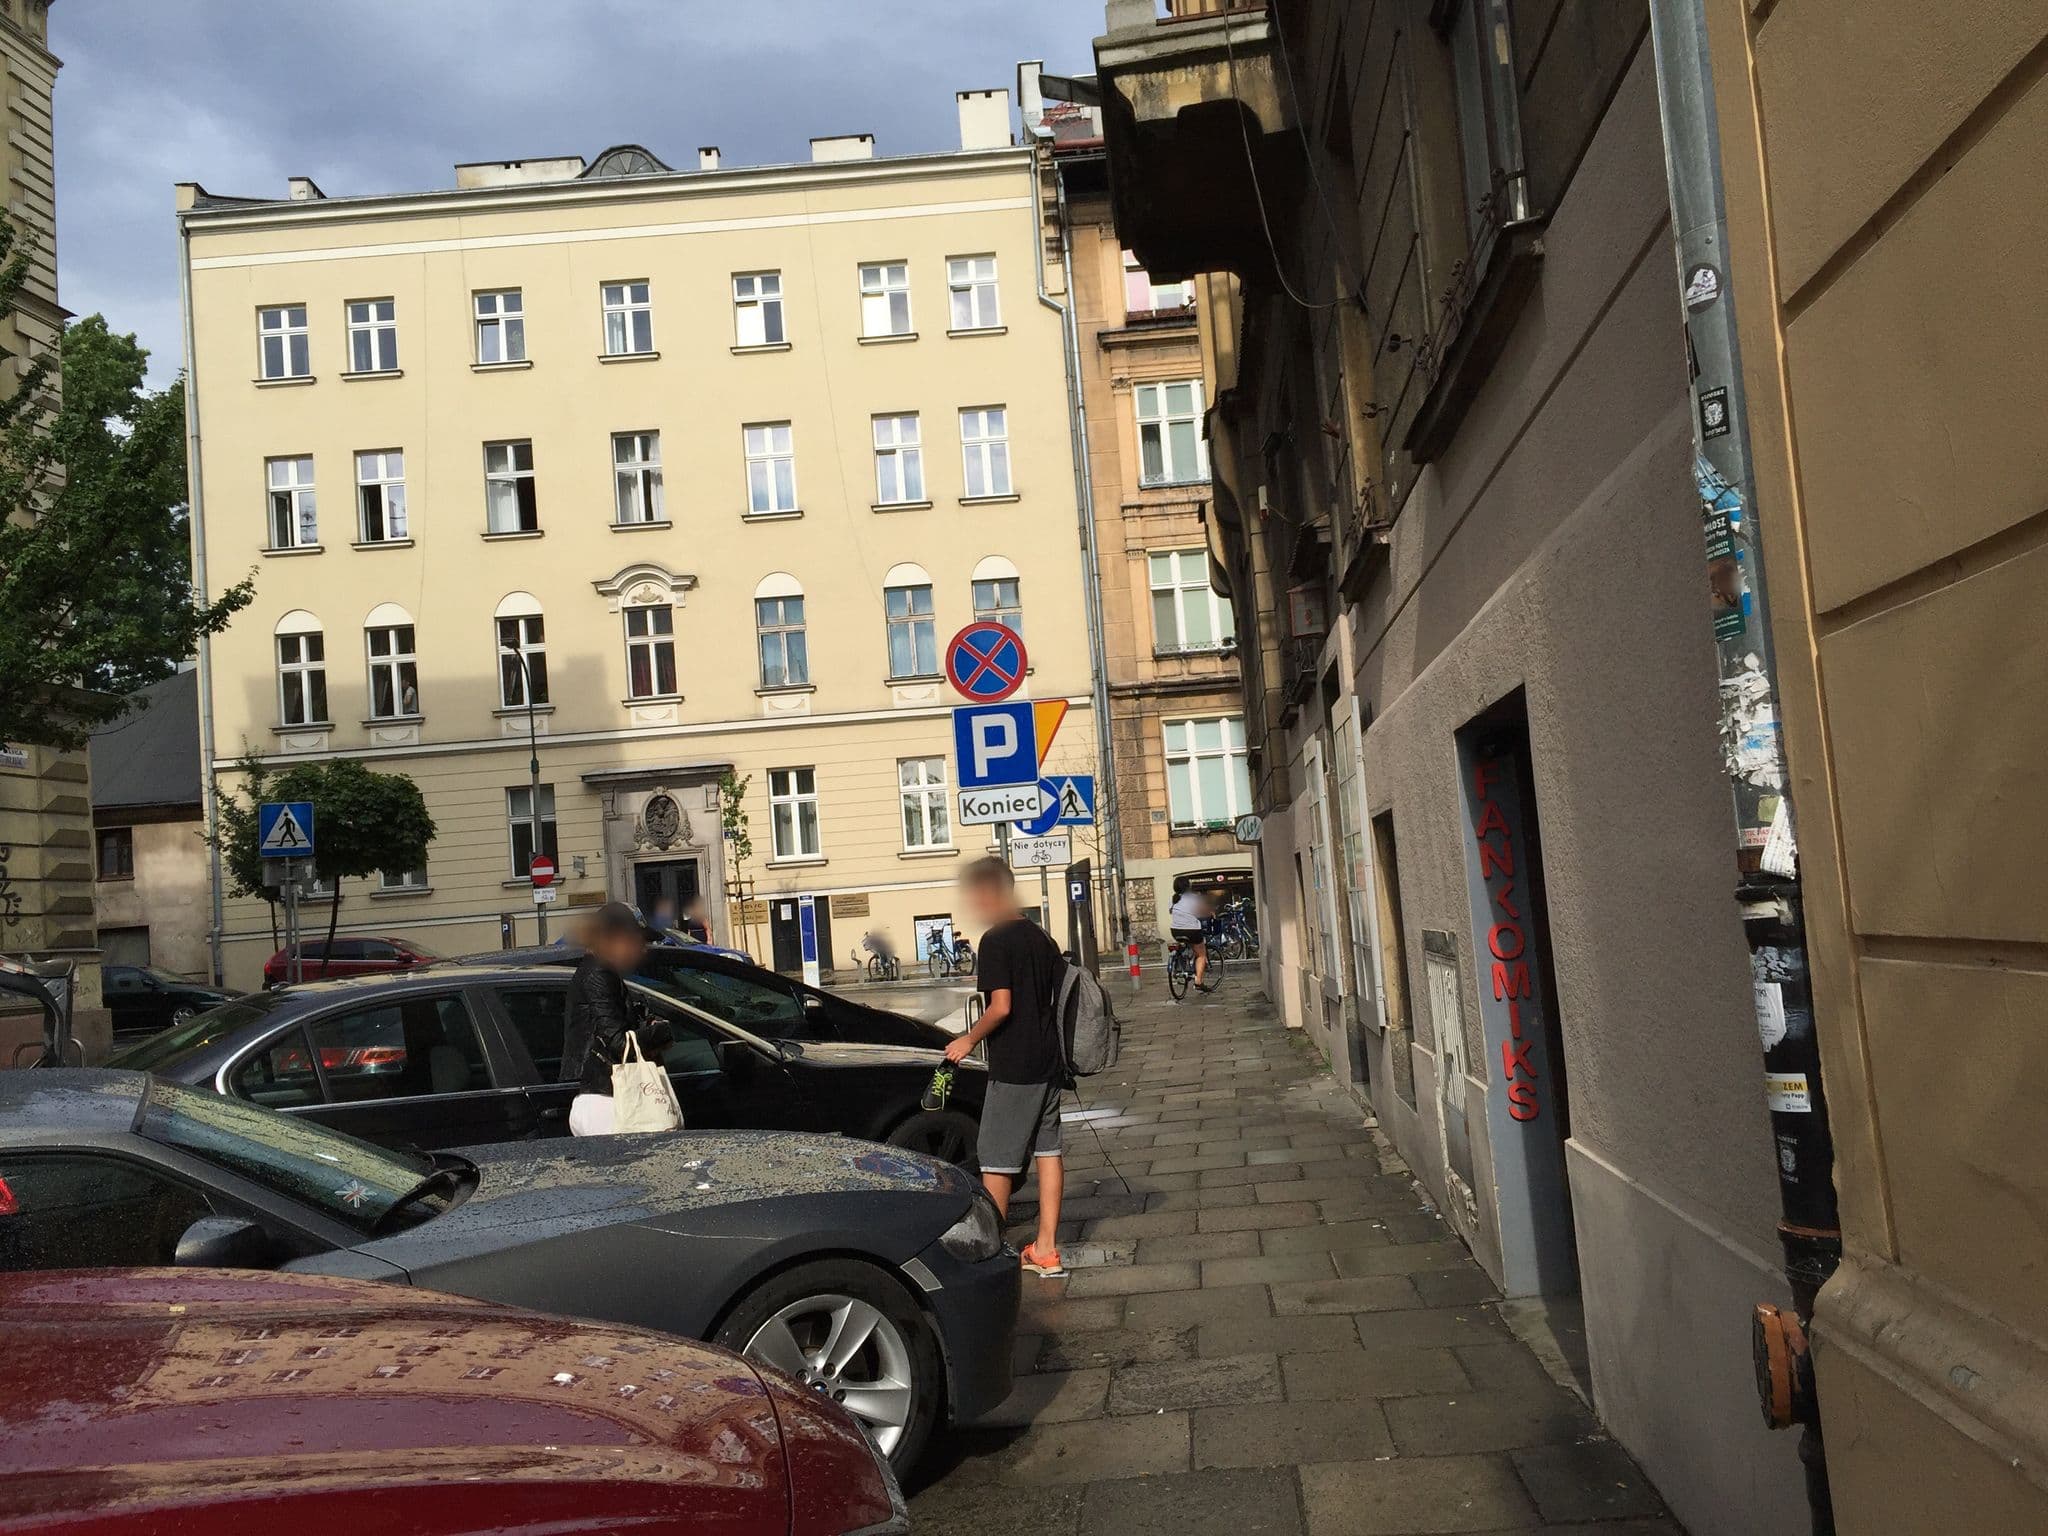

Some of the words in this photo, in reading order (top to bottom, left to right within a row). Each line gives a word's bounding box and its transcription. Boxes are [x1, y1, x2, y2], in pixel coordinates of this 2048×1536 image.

[971, 712, 1018, 778] P
[962, 793, 1038, 818] Koniec
[1014, 842, 1029, 850] Nie
[1033, 840, 1067, 849] dotyczy
[1070, 882, 1082, 900] P
